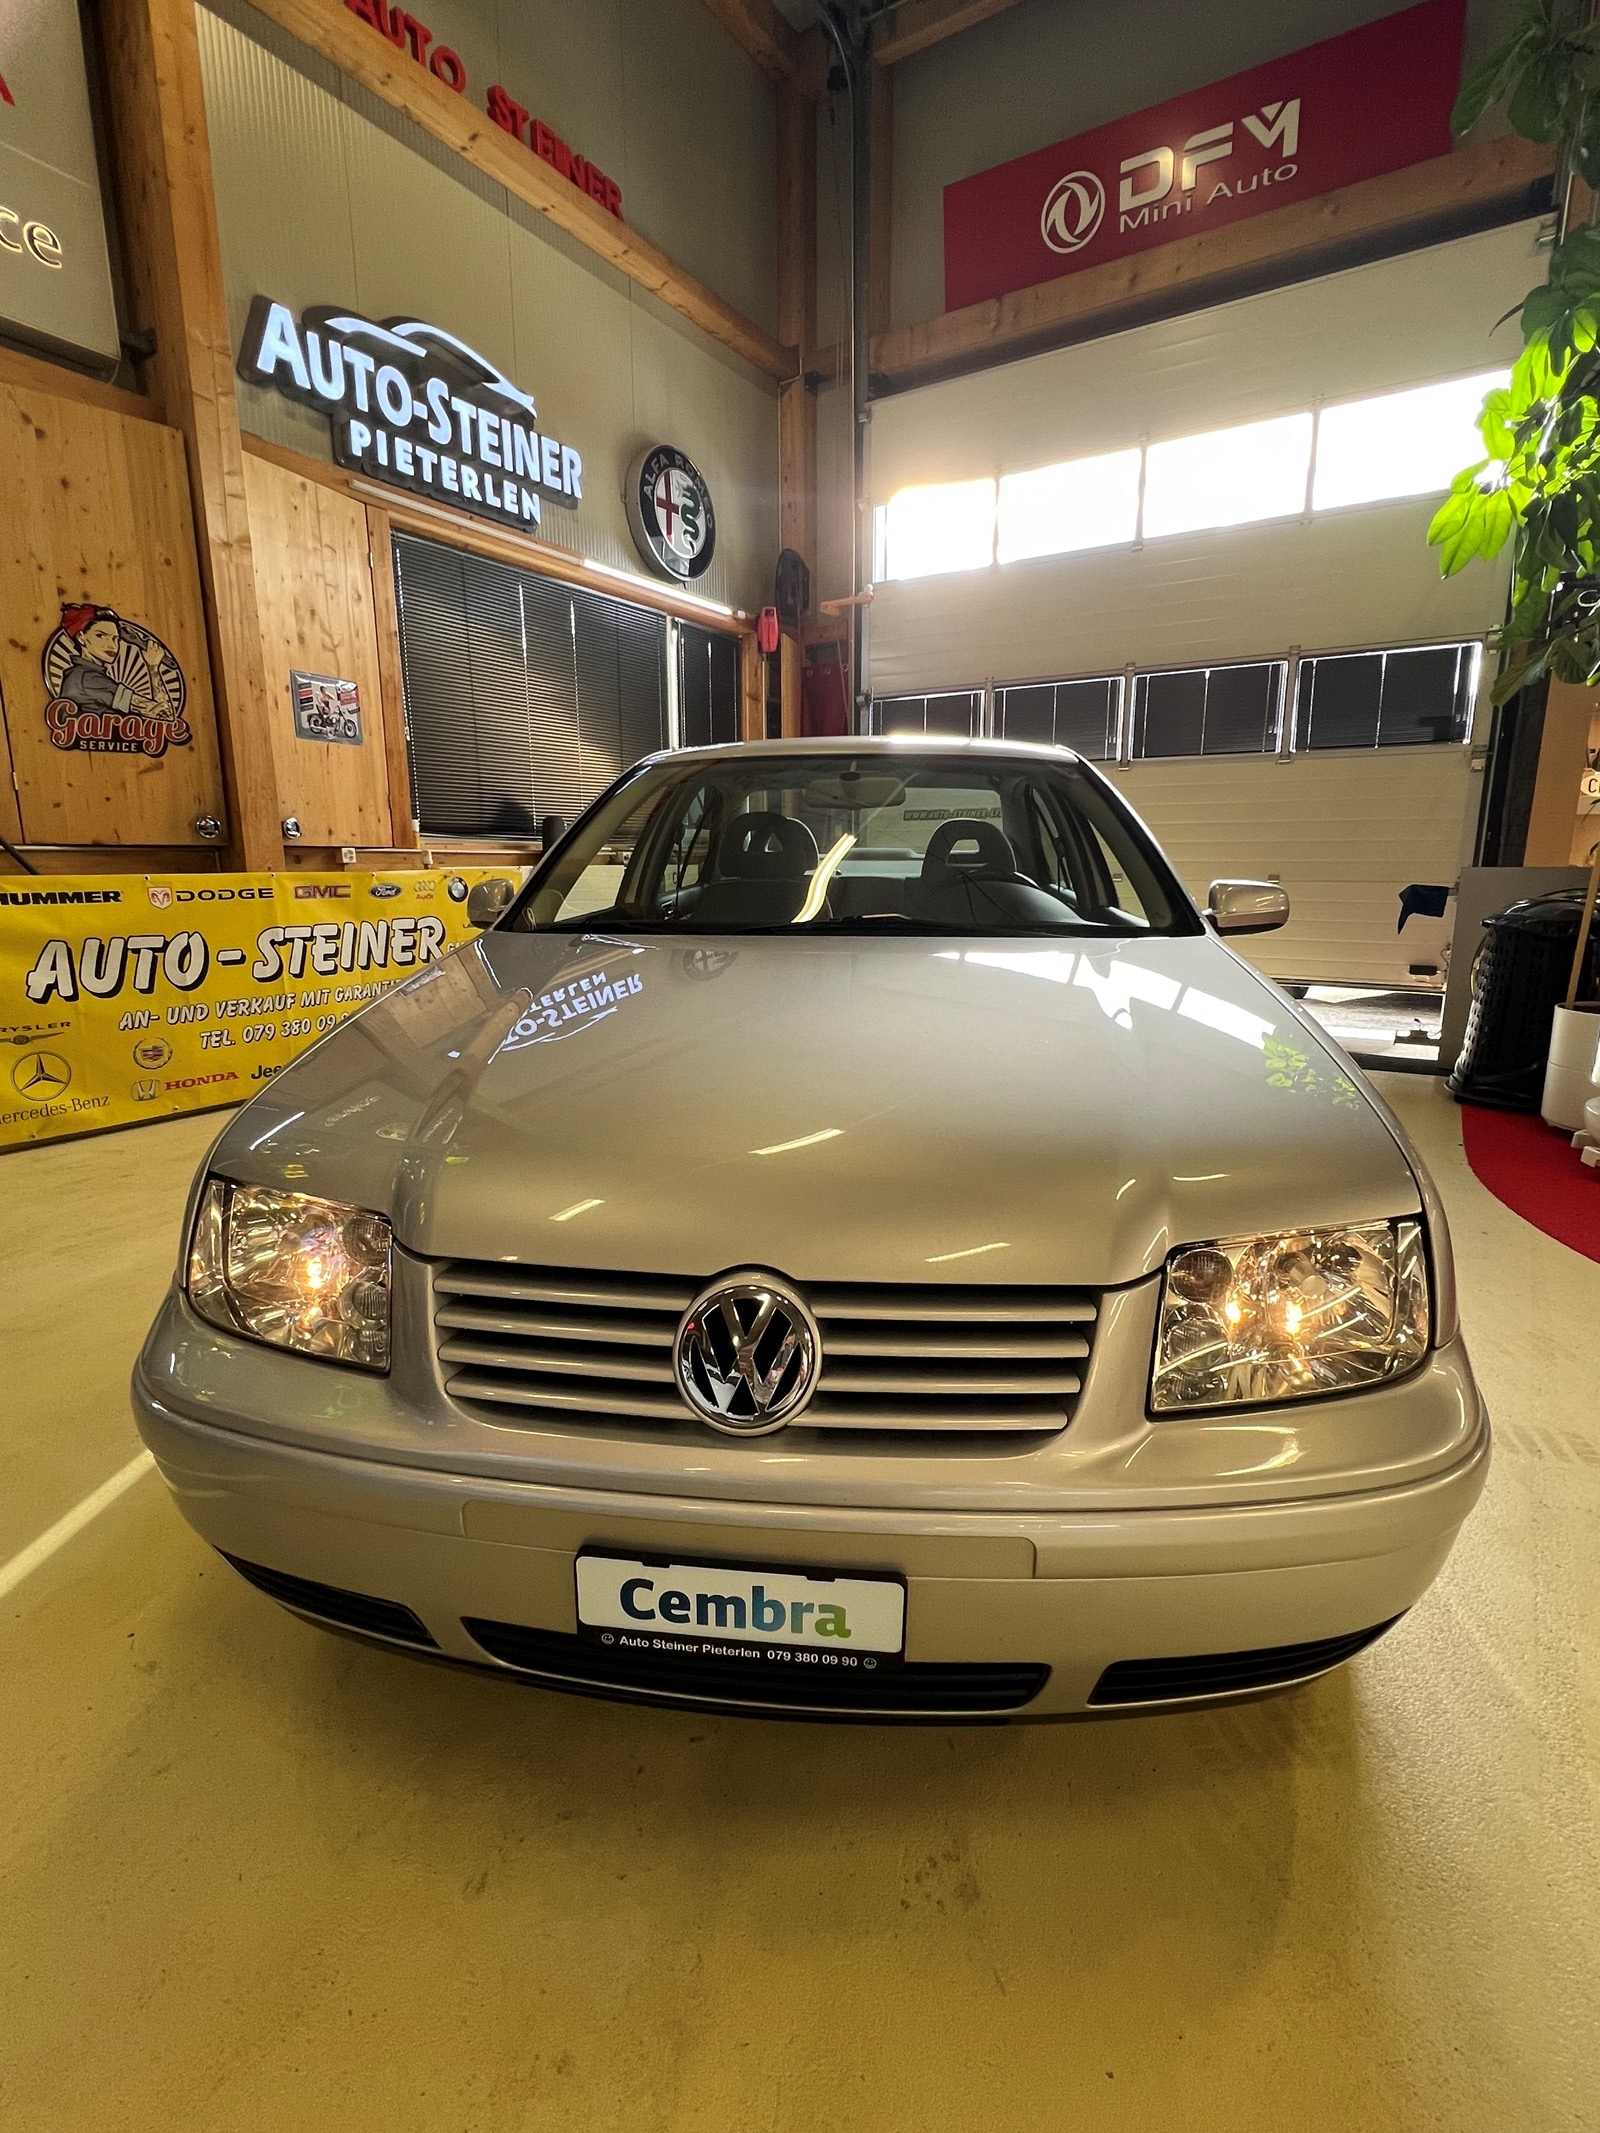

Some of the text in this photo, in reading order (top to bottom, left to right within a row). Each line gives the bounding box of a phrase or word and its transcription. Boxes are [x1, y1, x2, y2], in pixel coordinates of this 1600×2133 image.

[1119, 163, 1298, 234] Mini Auto
[256, 302, 583, 500] AUTO-STEINER
[349, 418, 541, 525] PIETERLEN
[46, 698, 192, 755] Garage
[79, 740, 138, 752] SERVICE
[176, 887, 274, 902] DODGE
[294, 884, 351, 900] GMC
[375, 884, 398, 896] Ford
[415, 892, 434, 901] Audi
[26, 931, 210, 1004] AUTO
[252, 915, 446, 984] STEINER
[119, 979, 402, 1031] AN- UND VERKAUF MIT GARANT
[200, 1028, 236, 1049] TEL.
[242, 1024, 277, 1044] 079
[280, 1019, 312, 1038] 380
[316, 1014, 337, 1033] 09
[164, 1071, 239, 1091] HONDA
[250, 1064, 285, 1080] Jee
[0, 1096, 111, 1125] ercedes-Benz
[619, 1577, 852, 1639] Cembra
[619, 1635, 650, 1649] Auto
[652, 1638, 700, 1655] Steiner
[767, 1649, 792, 1662] 079
[794, 1652, 819, 1665] 380
[822, 1655, 839, 1667] 09
[841, 1656, 858, 1668] 90
